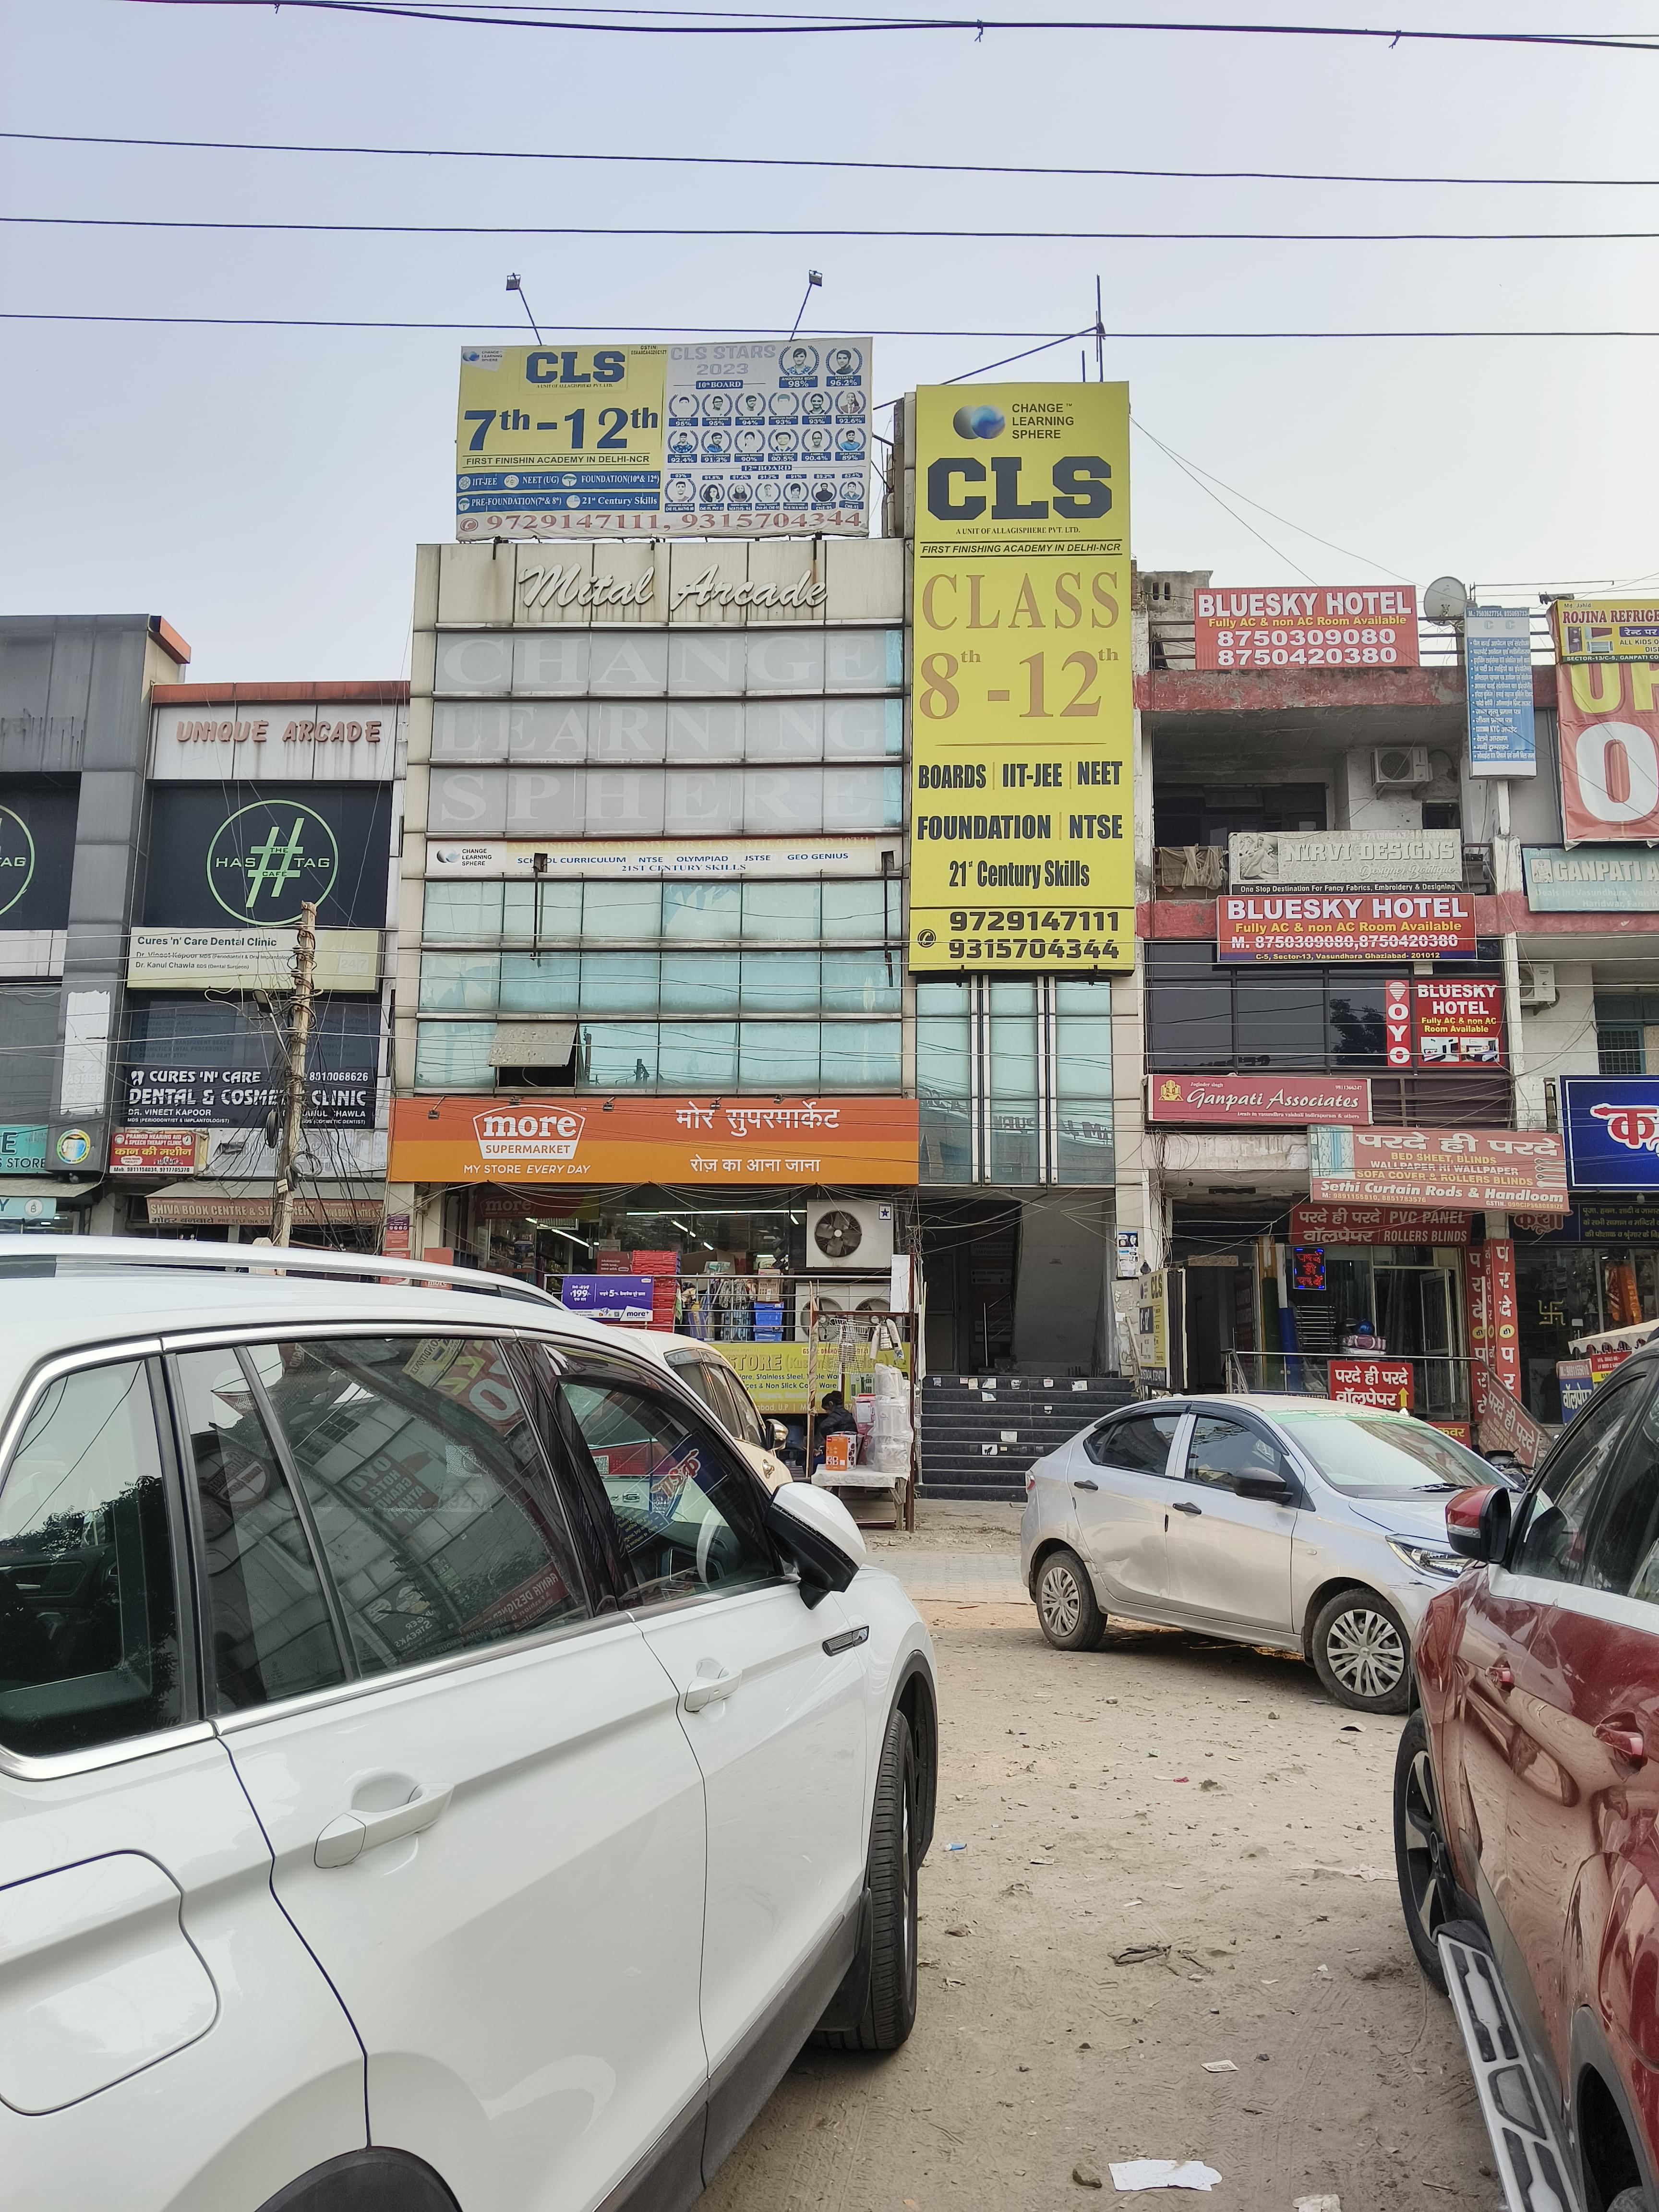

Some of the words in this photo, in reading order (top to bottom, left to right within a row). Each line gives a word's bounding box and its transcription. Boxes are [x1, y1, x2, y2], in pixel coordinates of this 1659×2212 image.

[671, 347, 707, 360] CLS
[714, 345, 776, 360] STARS
[526, 351, 625, 383] CLS
[697, 363, 748, 375] 2023
[1012, 404, 1063, 412] CHANGE
[1012, 417, 1074, 426] LEARNING
[1012, 430, 1061, 439] SPHERE
[472, 478, 497, 486] IIT-JEE
[544, 476, 559, 484] (UG)
[928, 456, 1112, 520] CLS
[598, 496, 631, 506] Century
[634, 496, 657, 504] Skills
[952, 545, 1001, 553] FINISHING
[1003, 544, 1053, 553] ACADEMY
[1055, 544, 1065, 552] IN
[1067, 543, 1120, 552] DELHI-NCR
[518, 563, 657, 608] Mital
[670, 564, 828, 611] Arcade
[922, 572, 1119, 631] CLASS
[1199, 593, 1318, 618] BLUESKY
[1327, 591, 1411, 615] HOTEL
[1209, 618, 1237, 629] Fully
[1240, 618, 1256, 627] AC
[1260, 618, 1269, 627] &
[1273, 618, 1293, 627] non
[1297, 617, 1314, 626] AC
[1317, 617, 1349, 625] Room
[1353, 616, 1407, 625] Available
[1563, 611, 1607, 623] ROJINA
[1217, 628, 1396, 647] 8750309080
[443, 635, 883, 686] CHANGE
[1217, 648, 1397, 666] 8750420380
[176, 720, 268, 742] UNIQUE
[282, 721, 382, 743] ARCADE
[435, 703, 881, 753] LEARNING
[918, 764, 986, 789] BOARDS
[1003, 763, 1062, 787] IIT-JEE
[1077, 761, 1123, 785] NEET
[440, 769, 874, 822] SPHERE
[917, 815, 1051, 840] FOUNDATION
[1070, 815, 1123, 839] NTSE
[1359, 842, 1455, 861] DESIGNS
[215, 857, 256, 868] HAS
[293, 857, 330, 867] TAG
[1553, 860, 1643, 882] GANPATI
[977, 860, 1041, 889] Century
[1045, 860, 1090, 887] Skills
[1324, 885, 1344, 893] Fancy
[1422, 883, 1455, 891] Designing
[1227, 898, 1363, 920] BLUESKY
[1372, 897, 1468, 919] HOTEL
[950, 912, 1118, 931] 9729147111
[1235, 922, 1267, 934] Fully
[1271, 922, 1290, 933] AC
[1294, 922, 1304, 933] &
[1308, 924, 1332, 933] non
[1336, 922, 1355, 932] AC
[1359, 922, 1396, 932] Room
[1400, 921, 1462, 932] Available
[138, 937, 168, 945] Cures
[184, 937, 208, 946] Care
[210, 937, 244, 946] Dental
[247, 938, 277, 947] Clinic
[949, 938, 1119, 959] 9315704344
[1418, 984, 1497, 998] BLUESKY
[1432, 1001, 1489, 1014] HOTEL
[1387, 1003, 1410, 1064] OYO
[149, 1070, 196, 1083] CURES
[222, 1071, 262, 1083] CARE
[129, 1089, 196, 1106] DENTAL
[1186, 1088, 1264, 1111] Ganpati
[1266, 1088, 1359, 1110] Associates
[483, 1116, 577, 1138] more
[485, 1145, 571, 1154] SUPERMARKET
[1356, 1131, 1431, 1150] परदे
[1438, 1133, 1479, 1153] ही
[1487, 1138, 1562, 1157] परदे
[690, 1154, 718, 1173] रोज़
[722, 1159, 742, 1172] का
[746, 1159, 781, 1172] आना
[785, 1159, 821, 1172] जाना
[1391, 1153, 1413, 1161] BED
[1417, 1153, 1454, 1164] SHEET,
[1457, 1155, 1497, 1165] BLINDS
[464, 1165, 481, 1174] MY
[484, 1165, 521, 1174] STORE
[527, 1165, 565, 1174] EVERY
[567, 1165, 591, 1174] DAY
[1357, 1170, 1385, 1179] SOFA
[1389, 1171, 1426, 1181] COVER
[1441, 1174, 1491, 1184] ROLLERS
[1493, 1176, 1533, 1187] BLINDS
[1321, 1181, 1359, 1193] Sethi
[1365, 1182, 1421, 1196] Curtain
[1426, 1185, 1463, 1198] Rods
[1468, 1188, 1479, 1199] &
[1485, 1189, 1563, 1202] Handloom
[151, 1204, 180, 1215] SHIVA
[181, 1205, 209, 1215] BOOK
[485, 1200, 531, 1211] more
[1299, 1208, 1329, 1224] परदे
[1332, 1208, 1348, 1223] ही
[1352, 1208, 1382, 1224] परदे
[1390, 1211, 1418, 1224] PVC
[1422, 1211, 1465, 1224] PANEL
[1384, 1231, 1427, 1242] ROLLERS
[1431, 1230, 1467, 1241] BLINDS
[1334, 1366, 1361, 1383] परदे
[1365, 1366, 1379, 1385] ही
[1382, 1366, 1408, 1385] परदे
[1336, 1387, 1397, 1406] वॉलपेपर
